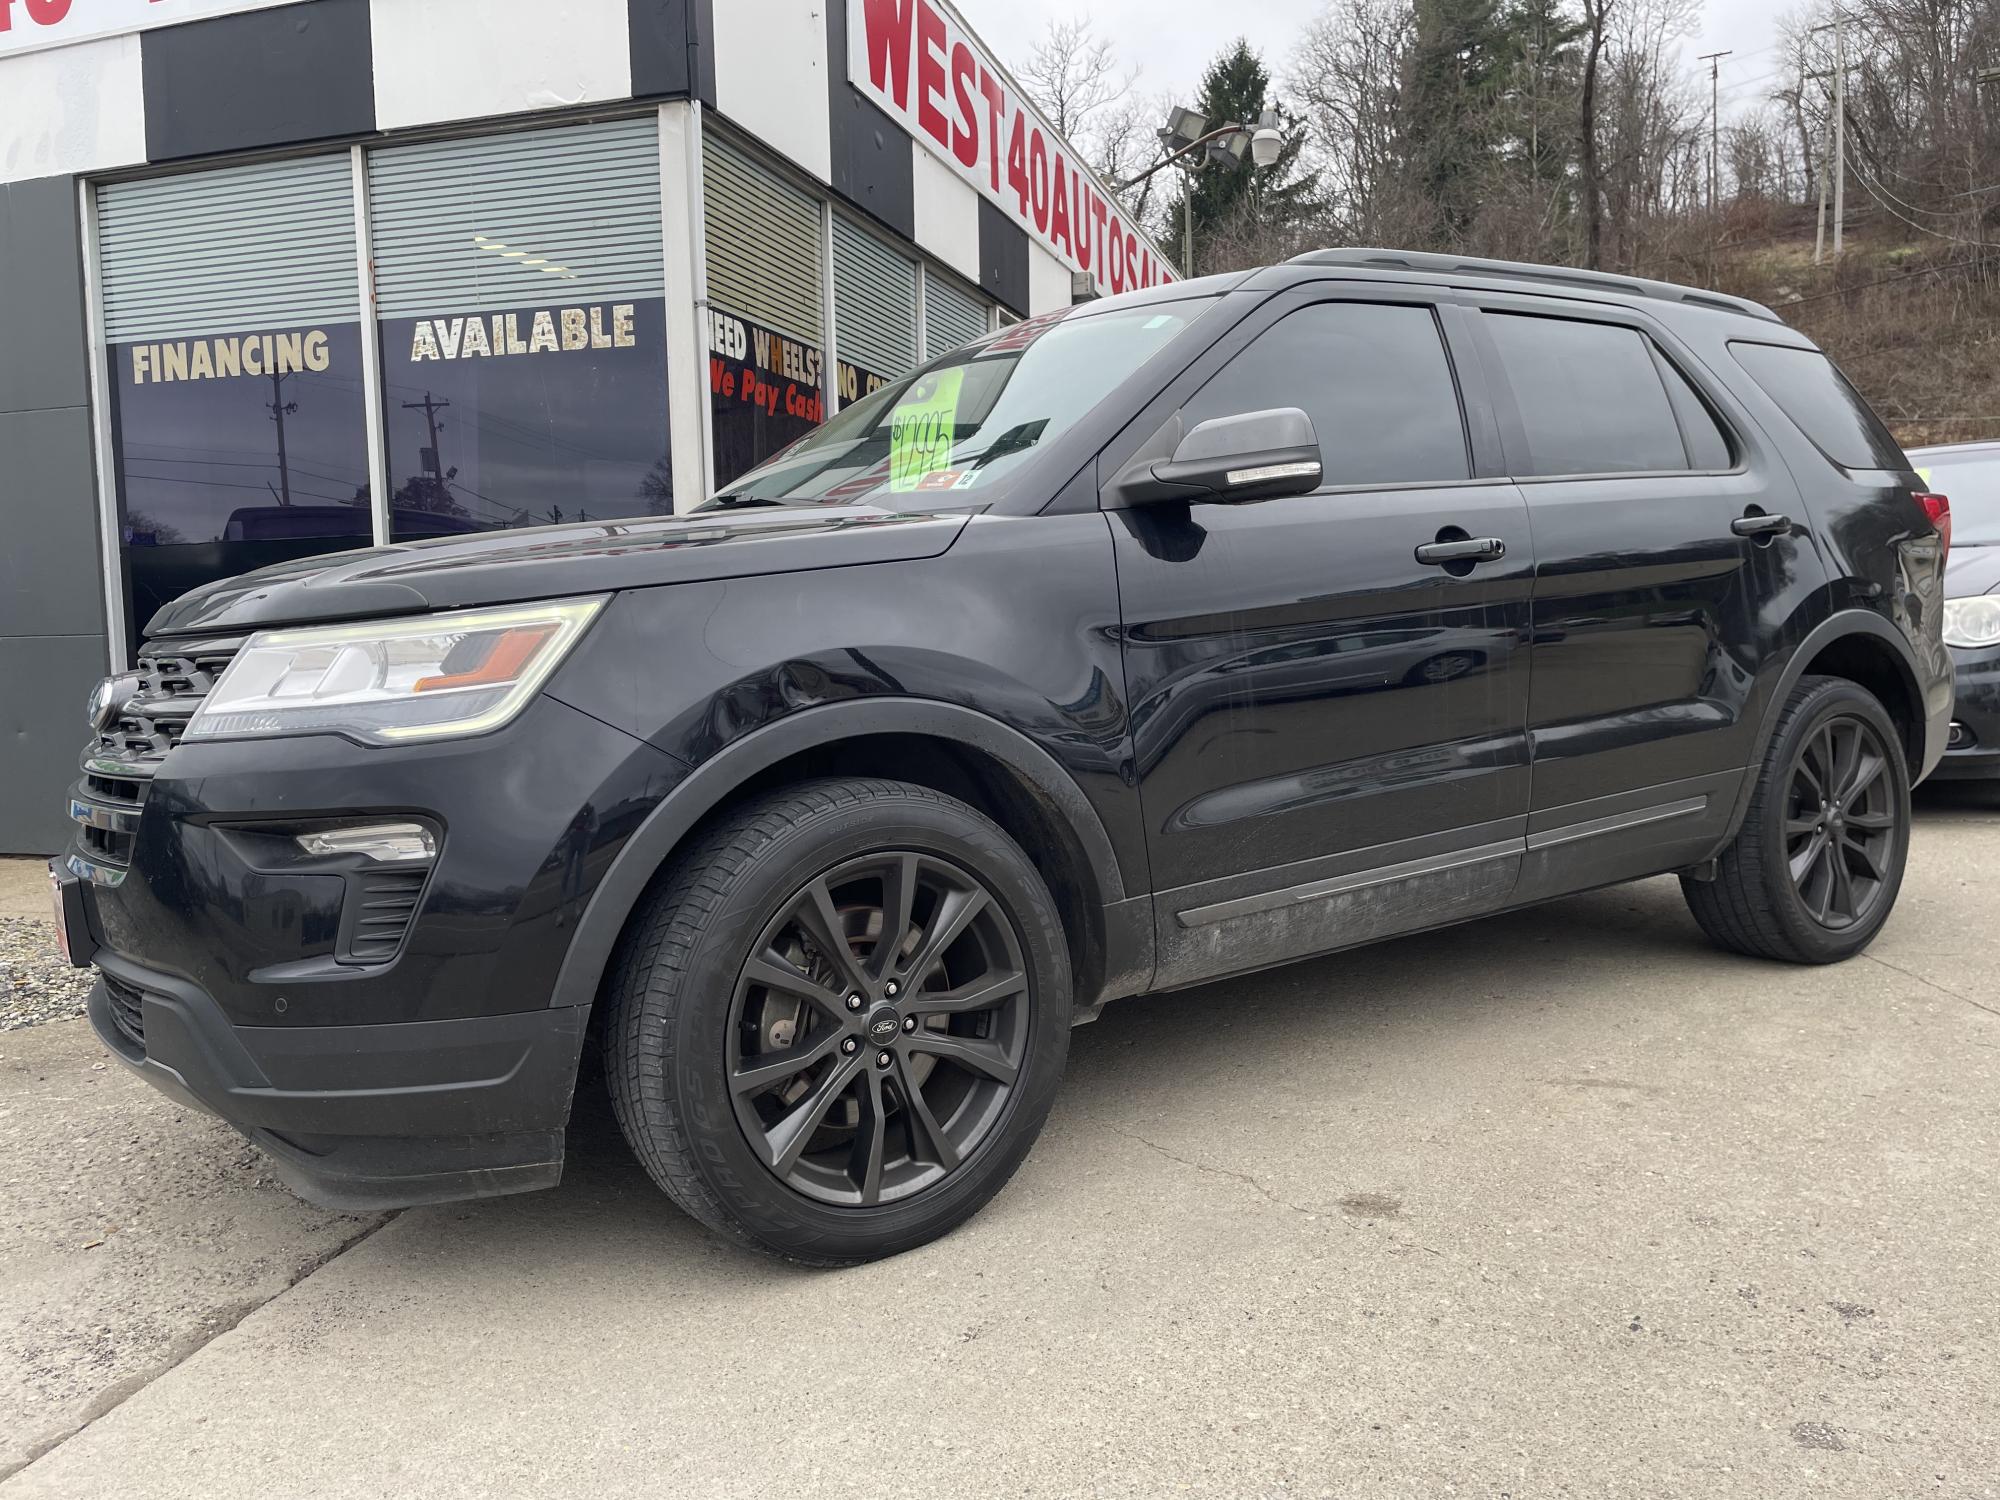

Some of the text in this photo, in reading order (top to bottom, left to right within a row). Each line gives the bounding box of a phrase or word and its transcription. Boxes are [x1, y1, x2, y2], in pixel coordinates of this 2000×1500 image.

[862, 0, 1005, 193] WEST
[1008, 108, 1050, 234] 40
[131, 329, 330, 385] FINANCING
[410, 304, 636, 362] AVAILABLE
[752, 327, 824, 390] WHEELS?
[710, 357, 824, 424] We Pay Cash
[837, 361, 857, 401] NO
[875, 1021, 895, 1032] Ford
